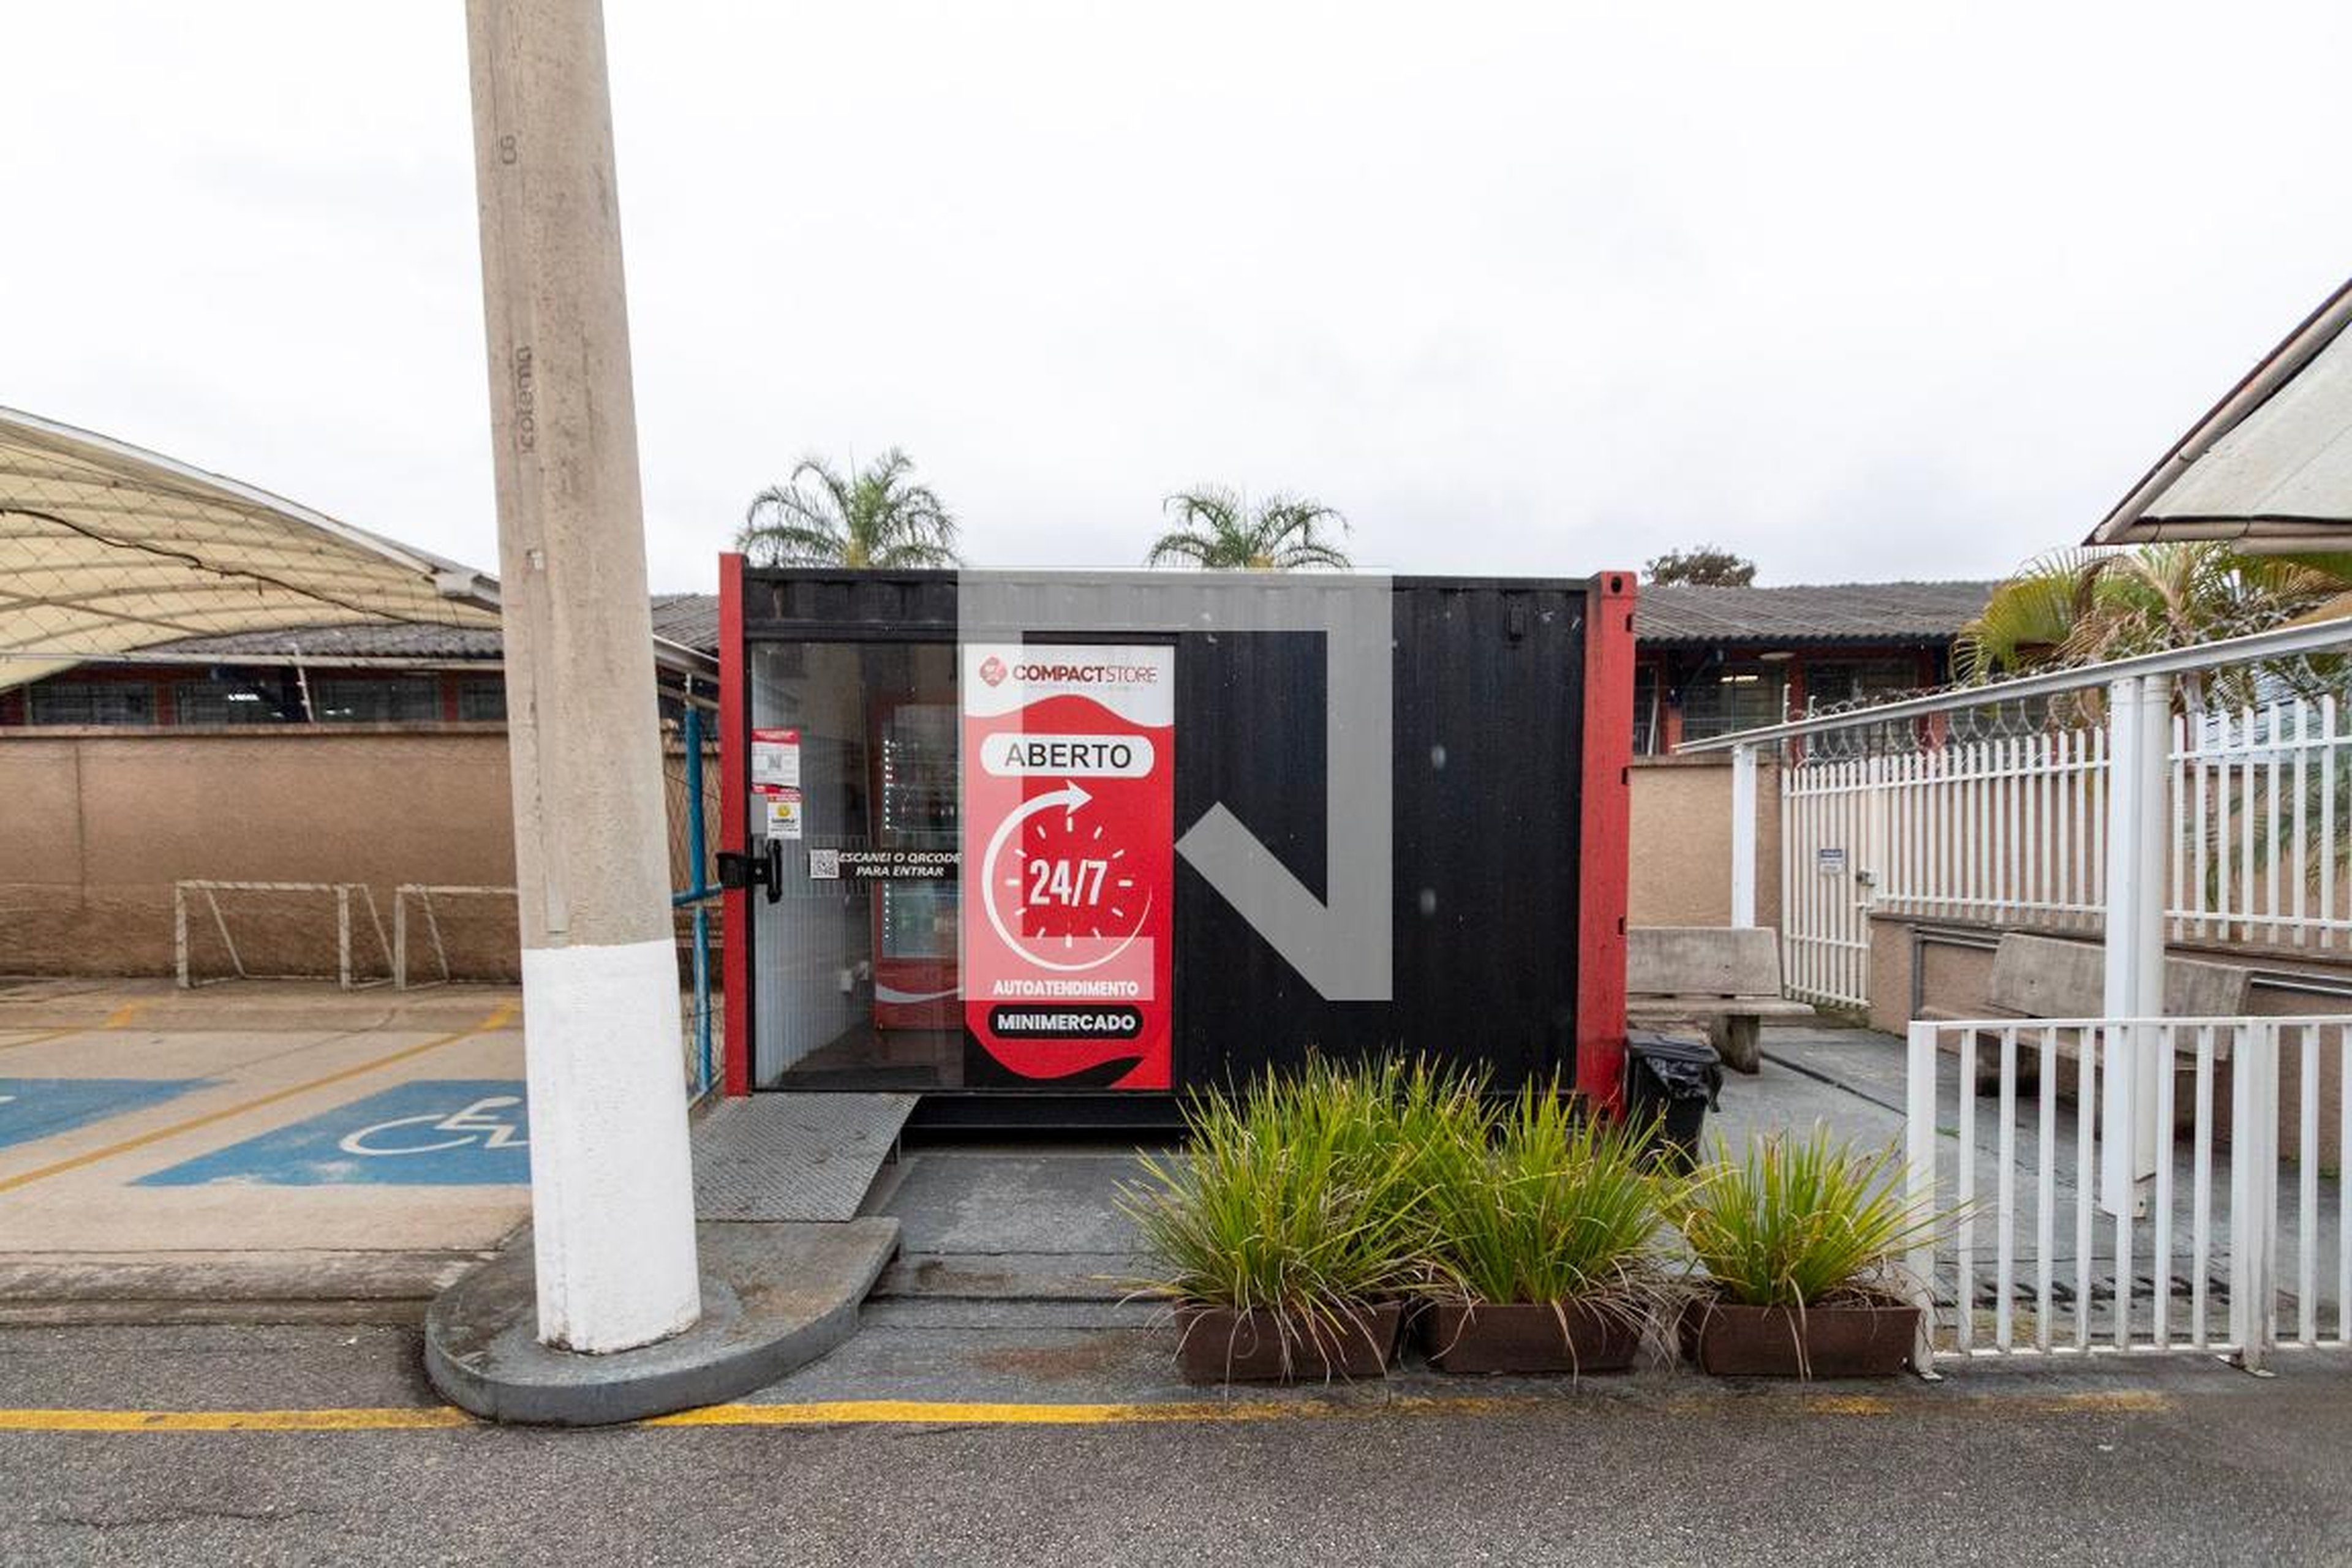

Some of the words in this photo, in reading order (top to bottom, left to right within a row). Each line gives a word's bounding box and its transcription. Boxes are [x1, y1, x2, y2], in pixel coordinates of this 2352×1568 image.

[1014, 665, 1158, 683] COMPACTSTORE
[1005, 743, 1131, 769] ABERTO
[894, 853, 905, 862] O
[908, 853, 962, 864] QRCODE
[856, 865, 889, 876] PARA
[892, 865, 944, 876] ENTRAR
[1029, 859, 1107, 907] 24/7
[993, 980, 1139, 997] AUTOATENDIMENTO
[997, 1014, 1136, 1030] MINIMERCADO
